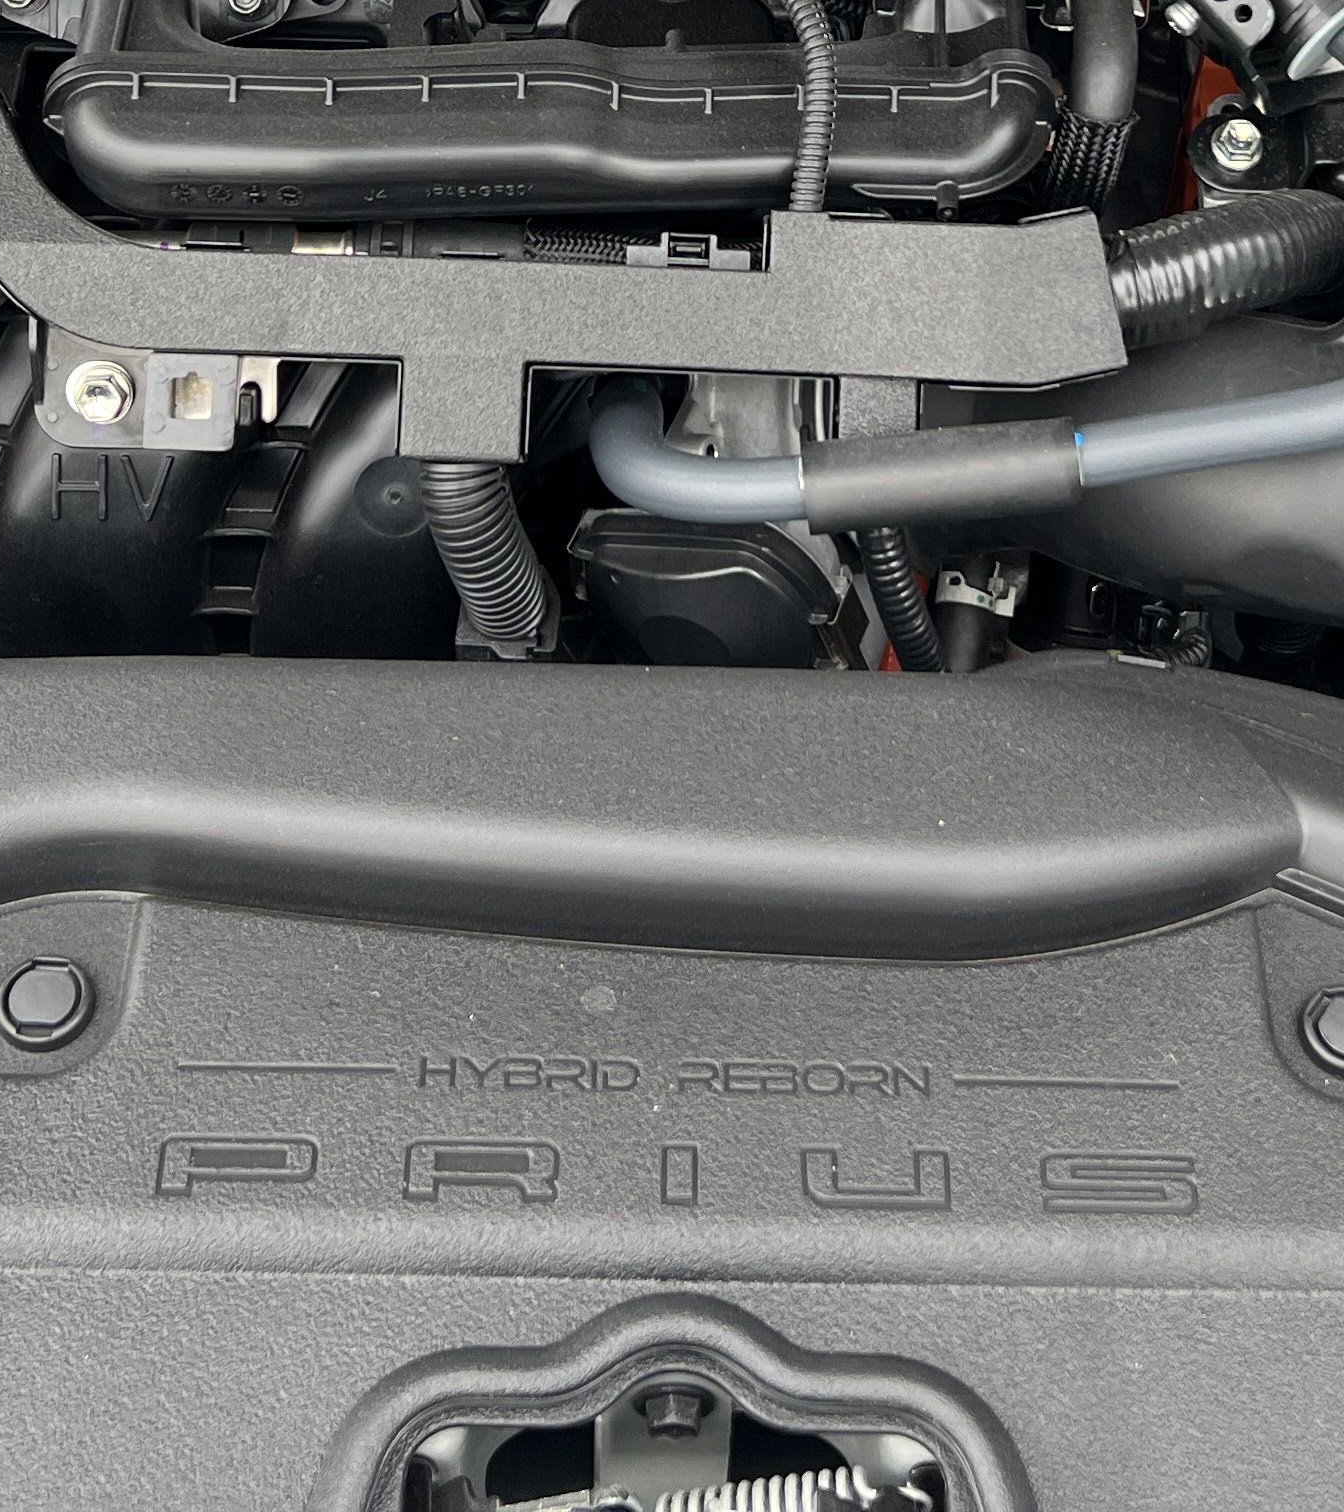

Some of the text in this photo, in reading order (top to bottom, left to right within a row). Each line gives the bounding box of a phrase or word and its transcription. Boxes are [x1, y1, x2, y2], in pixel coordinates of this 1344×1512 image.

[51, 452, 175, 522] HV
[418, 1057, 932, 1097] HYBRID REBORN
[155, 1134, 1200, 1214] PRIUS
